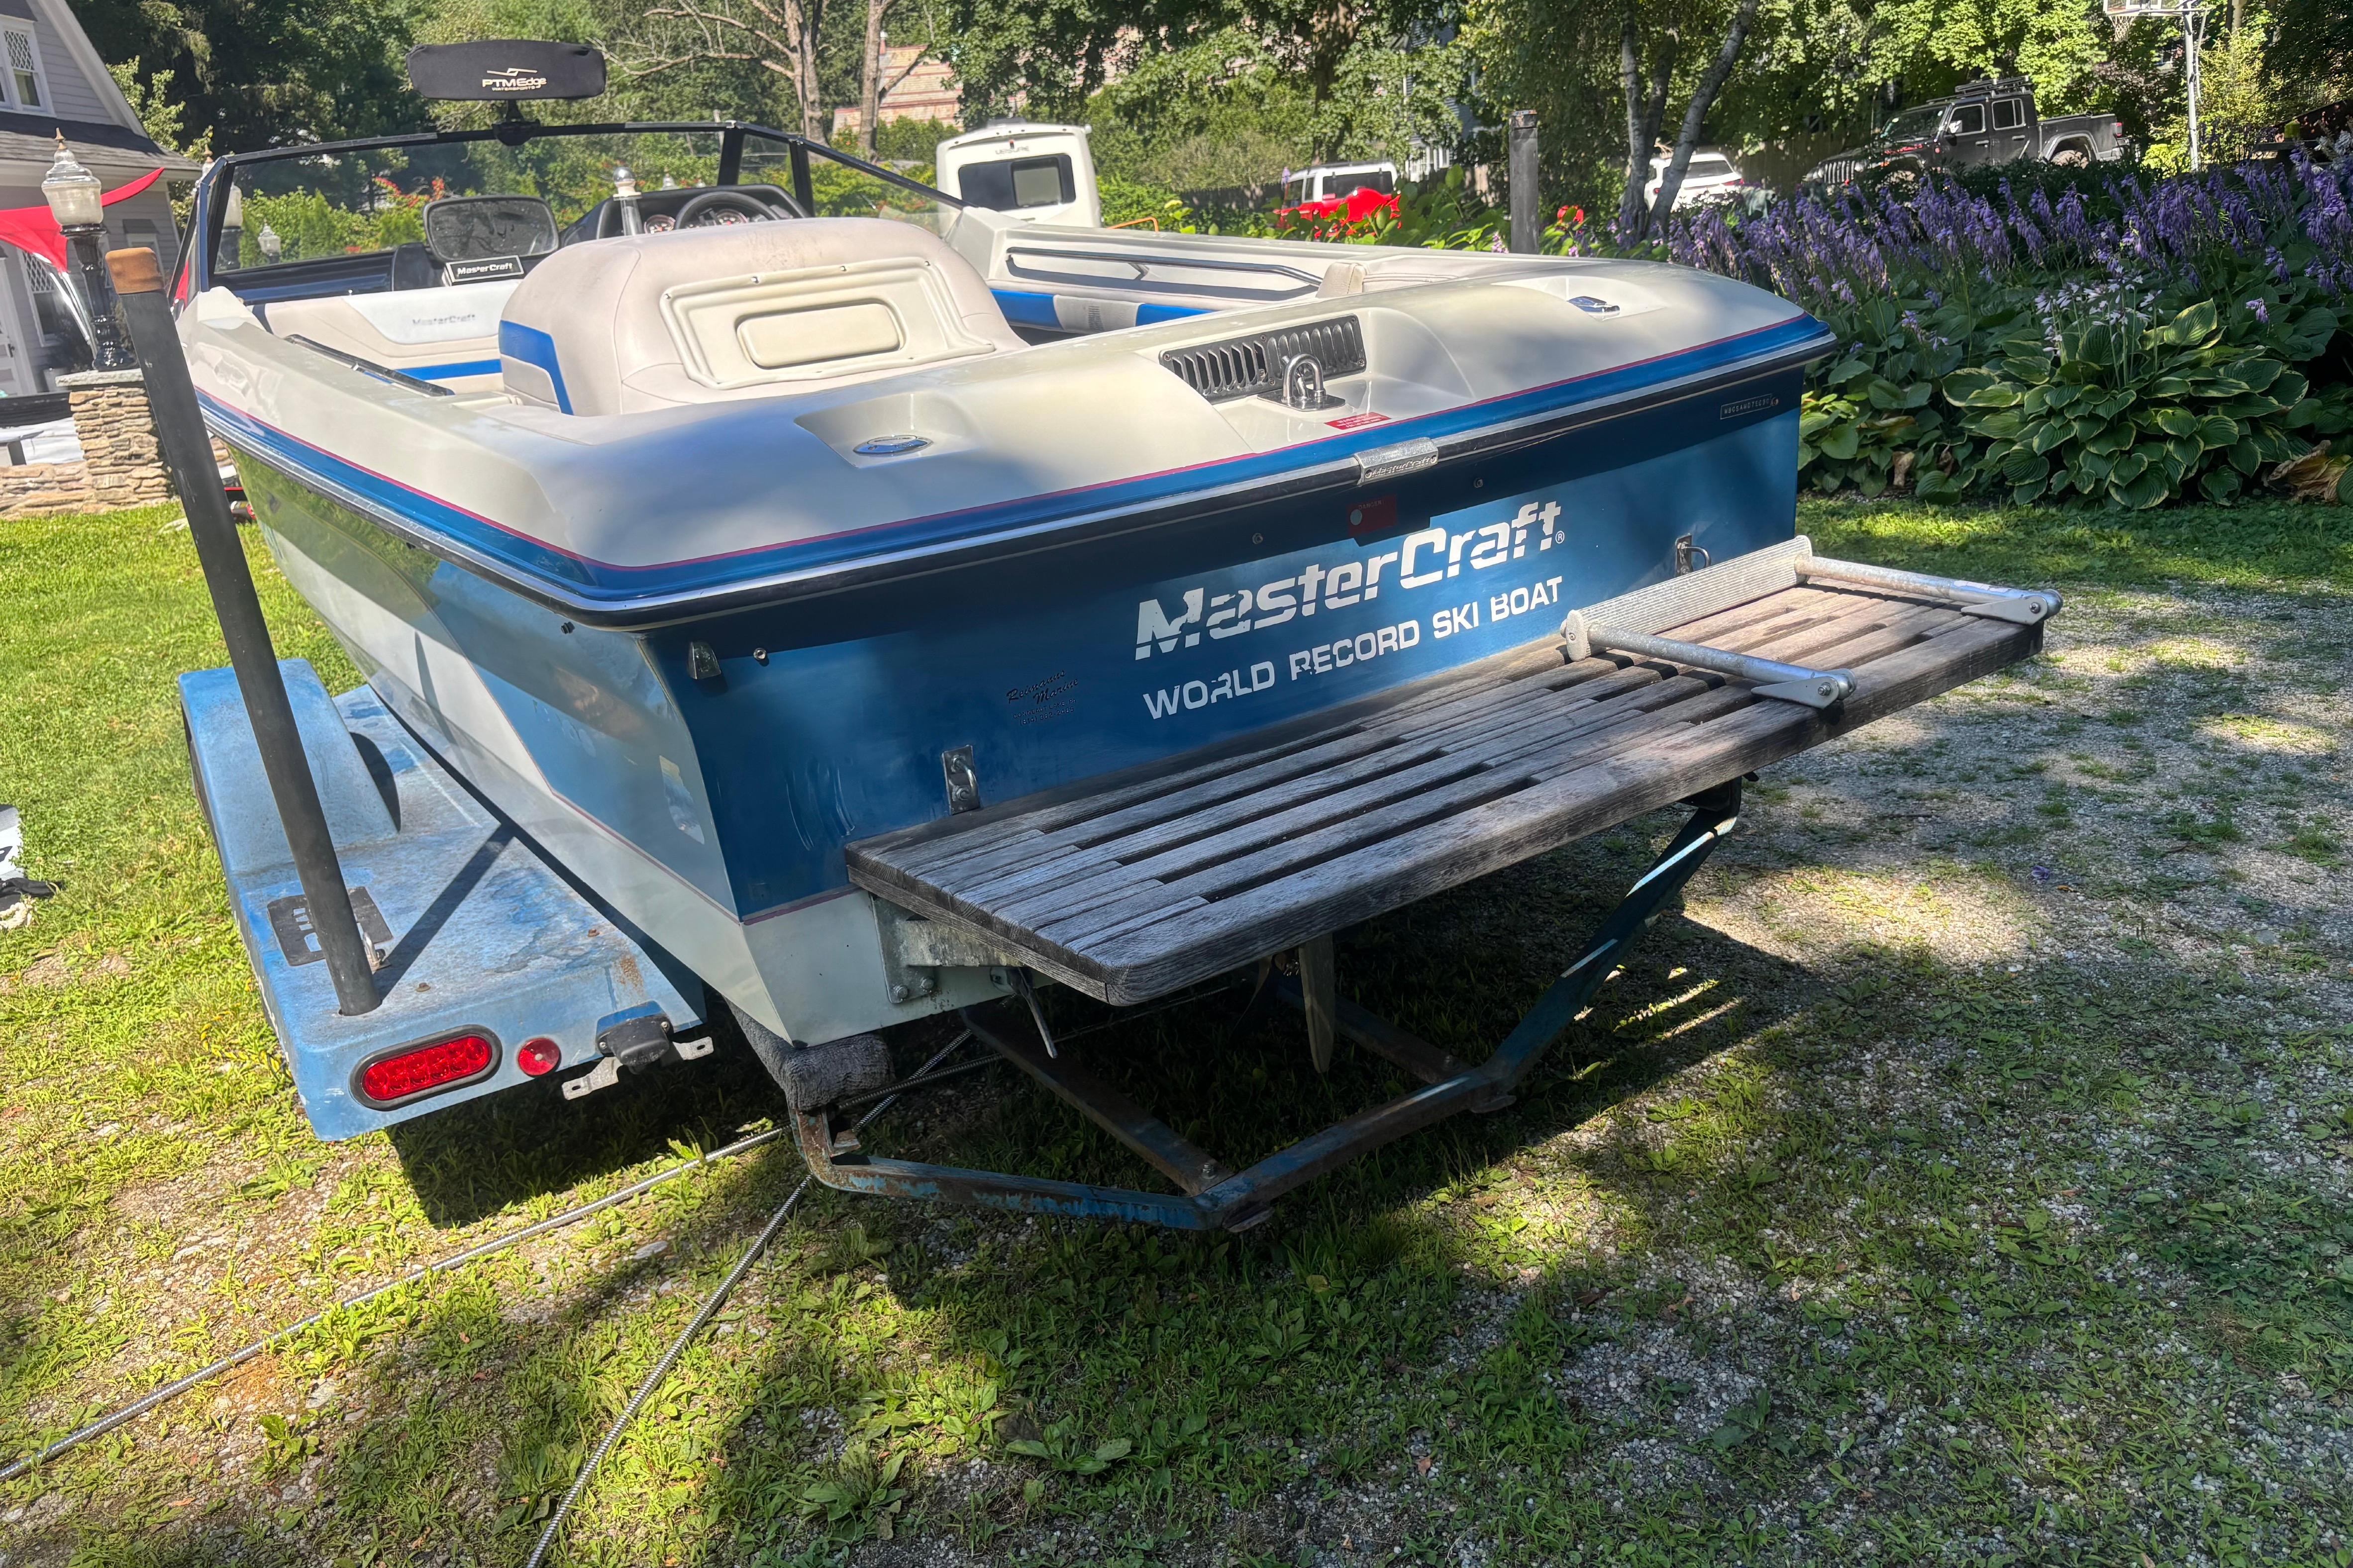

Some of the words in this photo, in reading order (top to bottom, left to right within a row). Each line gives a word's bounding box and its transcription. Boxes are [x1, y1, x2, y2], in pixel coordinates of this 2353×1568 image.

[457, 263, 512, 275] MasterCraft
[1372, 457, 1430, 477] MasterCraft
[1143, 661, 1275, 719] WORLD
[1290, 620, 1420, 681] RECORD
[1433, 602, 1478, 639] SKI
[1491, 576, 1562, 622] BOAT
[1033, 679, 1078, 704] Marine
